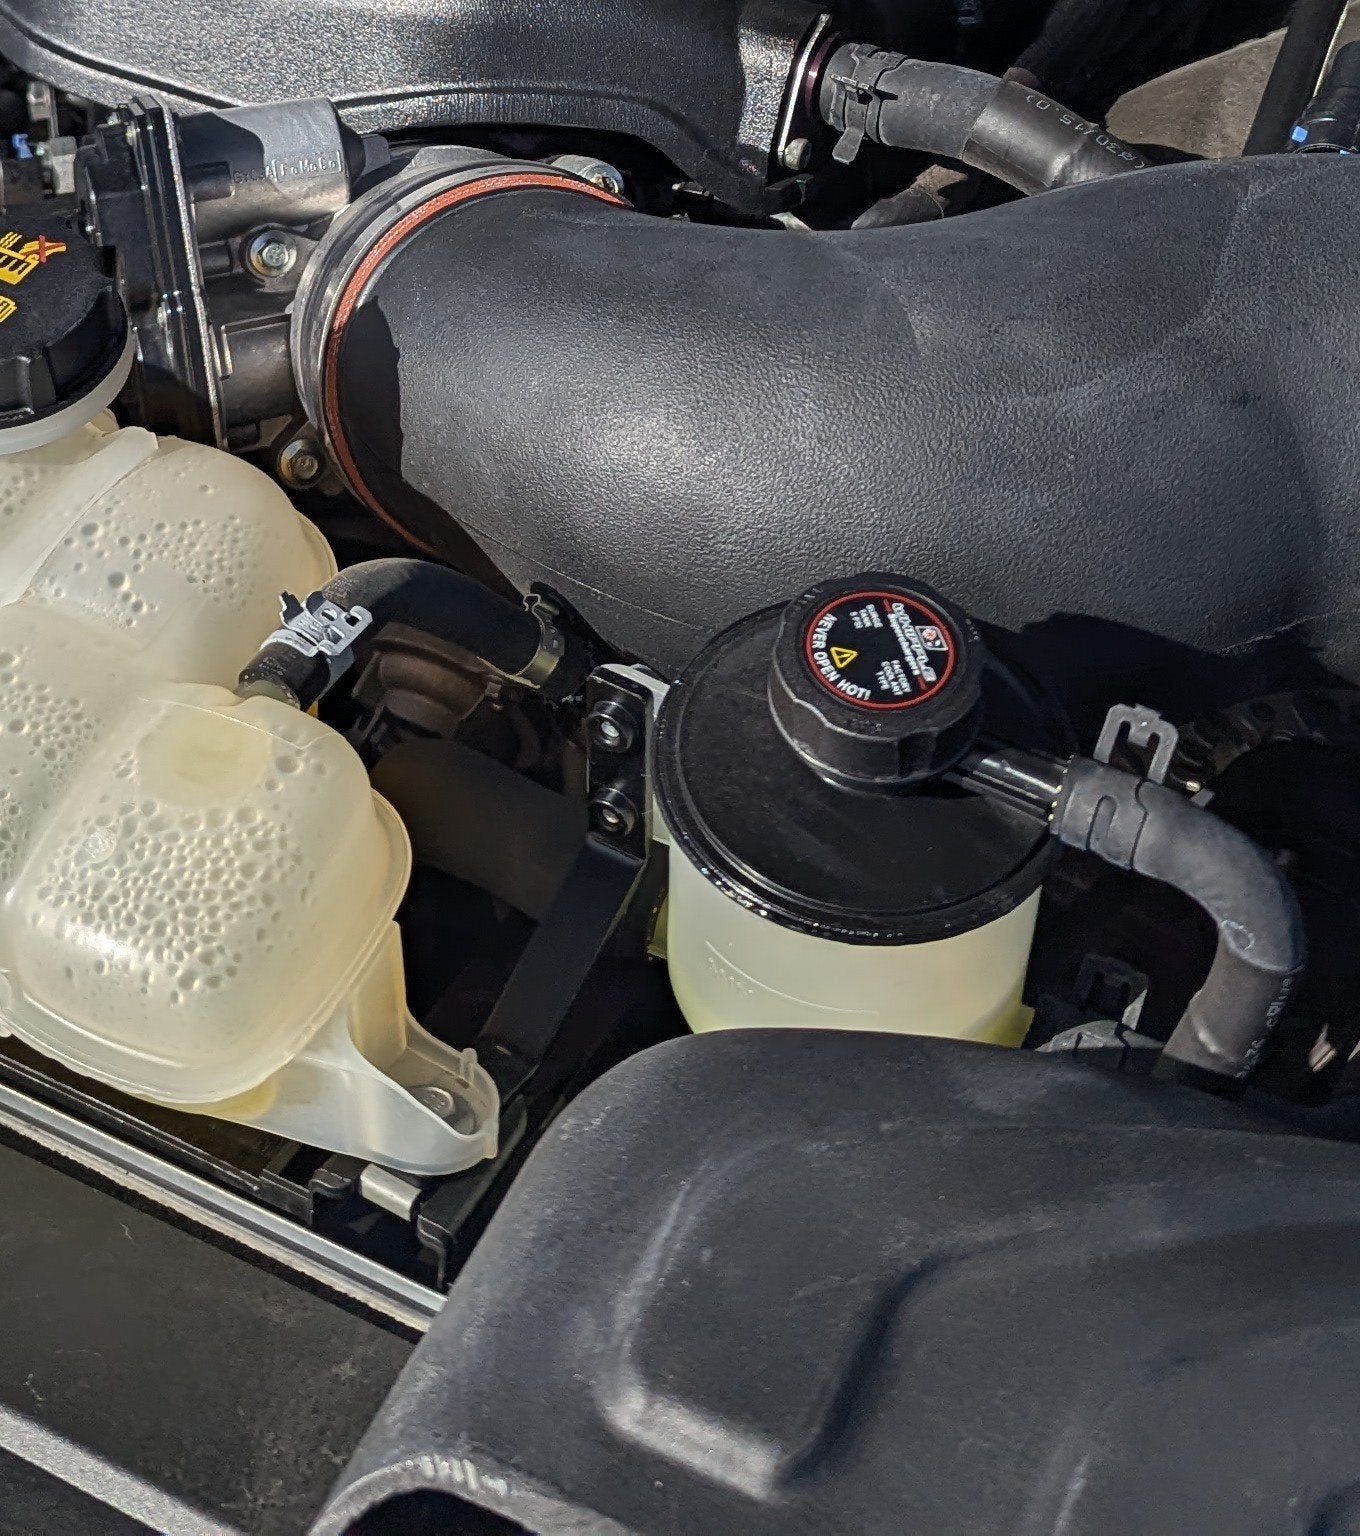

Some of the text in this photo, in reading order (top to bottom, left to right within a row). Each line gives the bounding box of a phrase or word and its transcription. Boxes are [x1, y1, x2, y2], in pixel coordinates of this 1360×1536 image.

[859, 609, 873, 628] TANK
[812, 613, 872, 701] NEVER OPEN HOT!
[875, 670, 891, 690] TYPE
[880, 660, 904, 696] COOLANT
[890, 659, 912, 693] FACTORY
